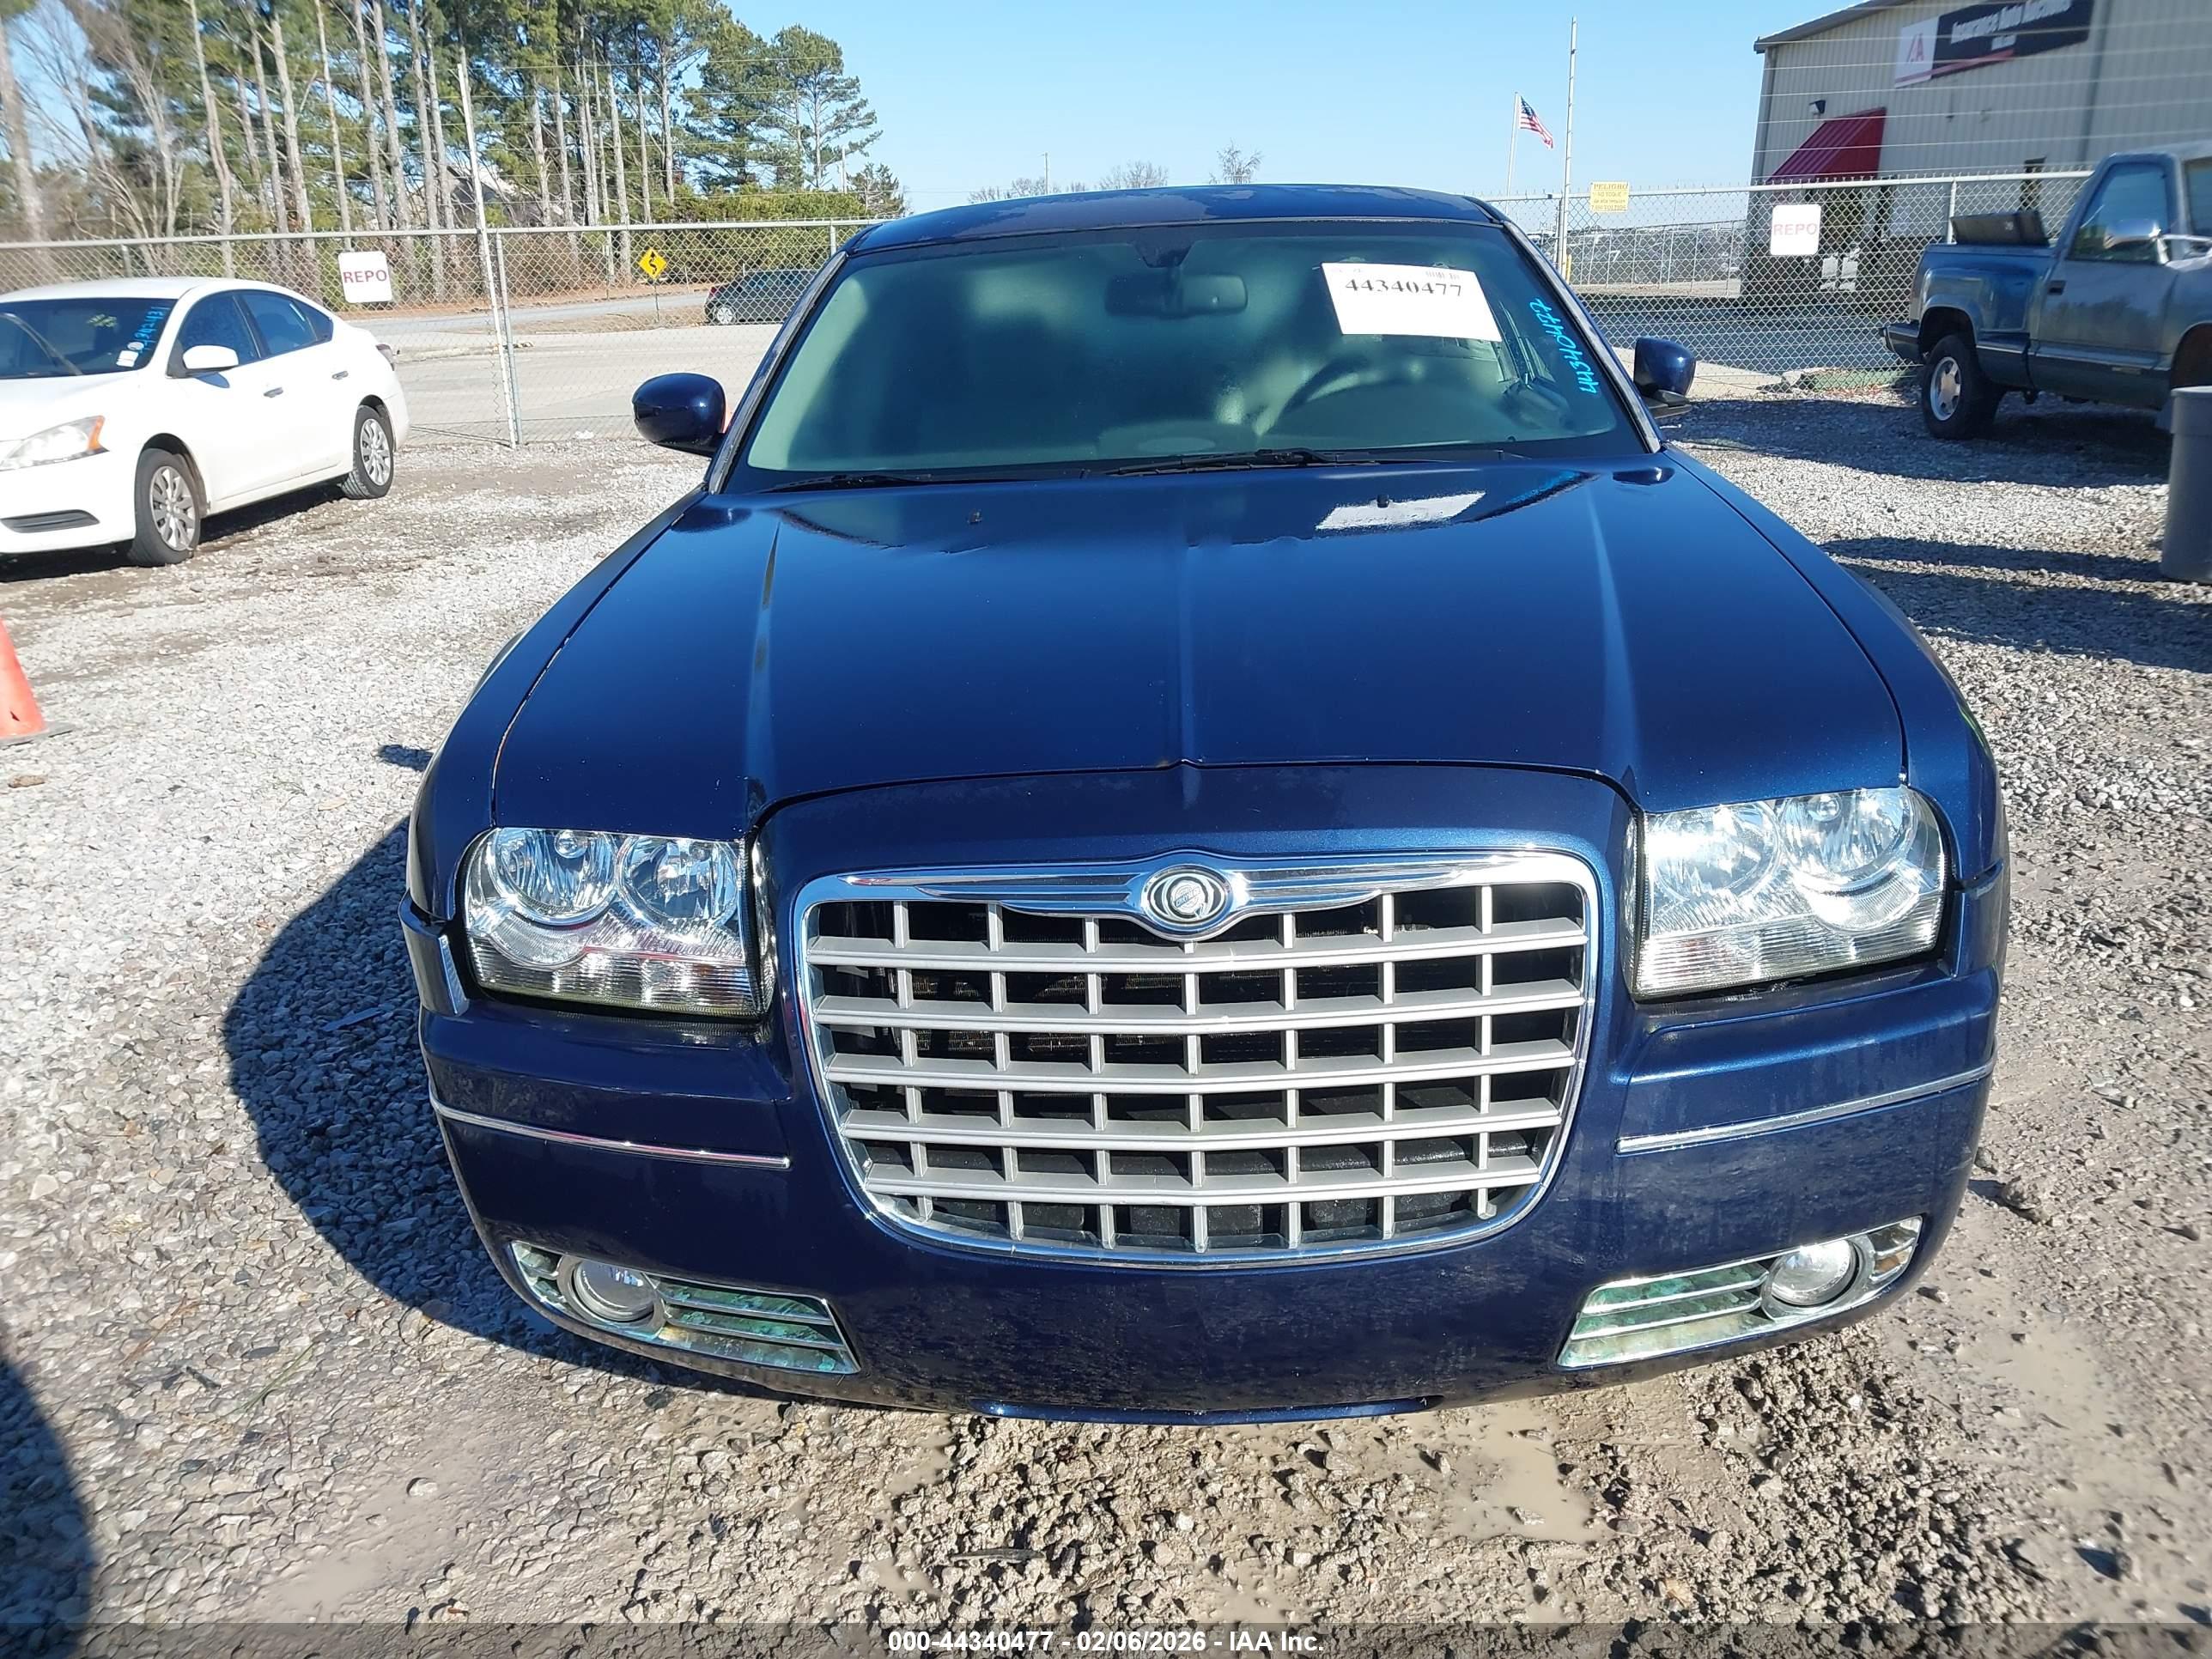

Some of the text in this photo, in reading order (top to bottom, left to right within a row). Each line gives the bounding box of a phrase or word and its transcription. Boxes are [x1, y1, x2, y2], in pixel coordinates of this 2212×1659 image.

[1773, 223, 1818, 236] REPO
[343, 269, 387, 283] REPO
[1345, 278, 1462, 297] 44340477
[1528, 297, 1600, 395] 44340477
